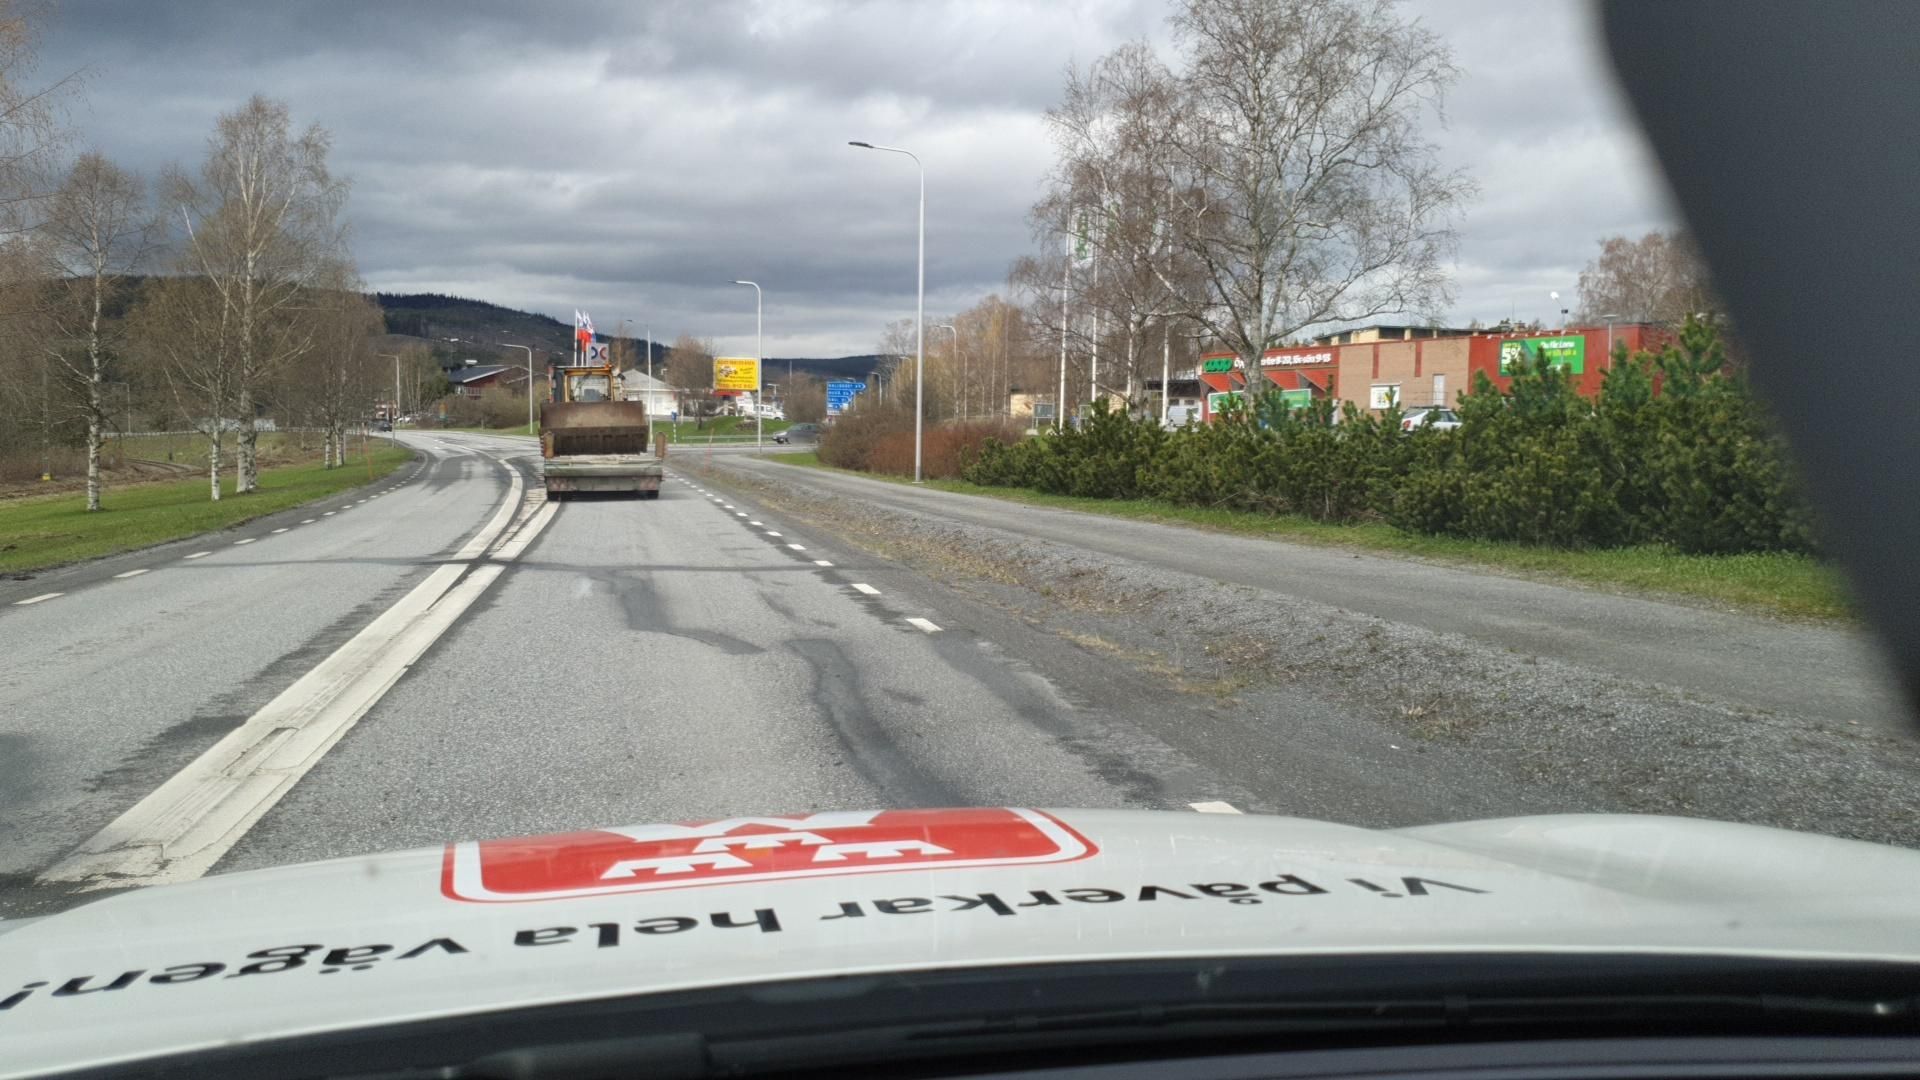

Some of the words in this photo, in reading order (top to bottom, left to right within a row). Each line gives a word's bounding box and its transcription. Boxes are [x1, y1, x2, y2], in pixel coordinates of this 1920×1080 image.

[822, 873, 1329, 917] påverkar
[1349, 875, 1492, 898] Vi
[513, 909, 783, 949] hela
[0, 937, 470, 1010] vägen!
